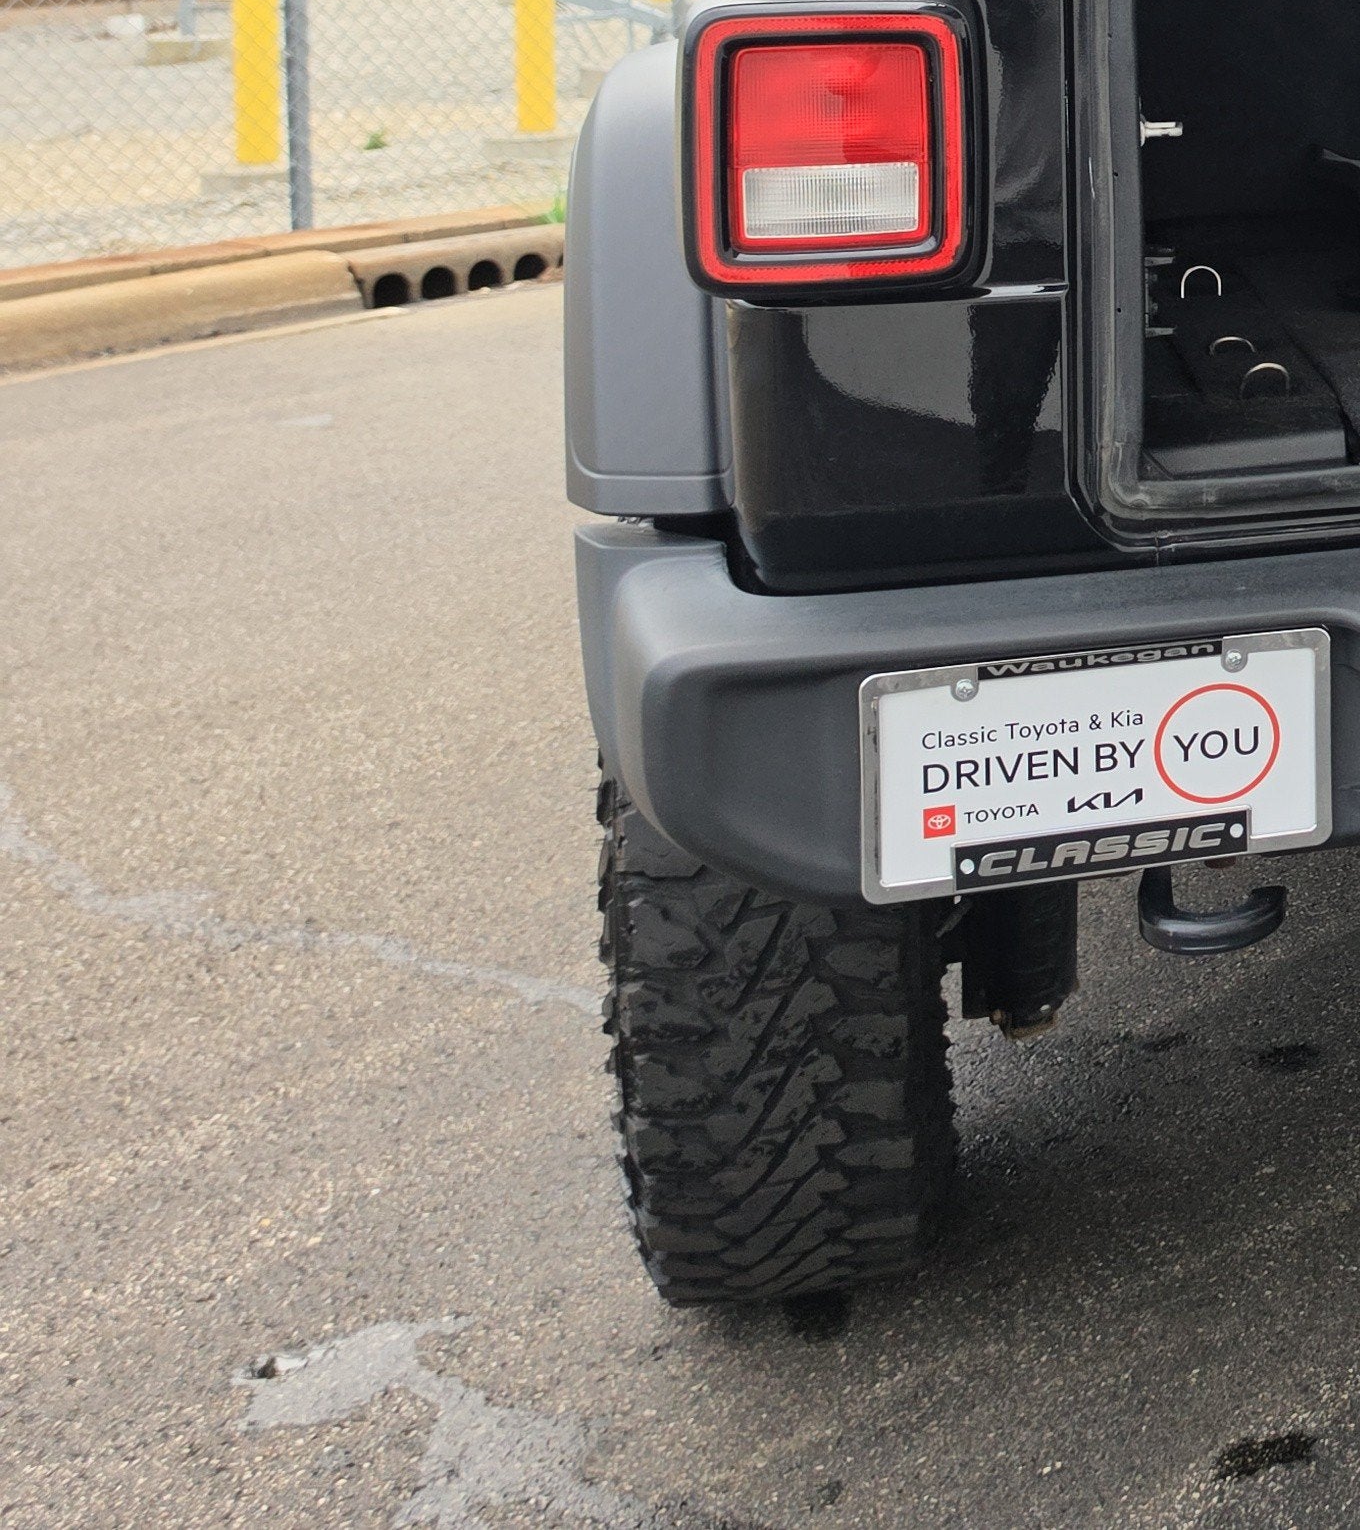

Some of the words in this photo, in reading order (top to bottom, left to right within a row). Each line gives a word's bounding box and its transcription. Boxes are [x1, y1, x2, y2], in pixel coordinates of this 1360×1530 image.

[985, 641, 1216, 678] Waukegan
[921, 724, 998, 751] Classic
[1007, 717, 1080, 743] Toyota
[1088, 713, 1102, 731] &
[1110, 709, 1145, 729] Kia
[922, 746, 1080, 795] DRIVEN
[1094, 738, 1147, 773] BY
[1172, 725, 1261, 763] YOU
[963, 803, 1040, 826] TOYOTA
[1066, 787, 1145, 814] KIA
[976, 821, 1227, 878] CLASSIC
